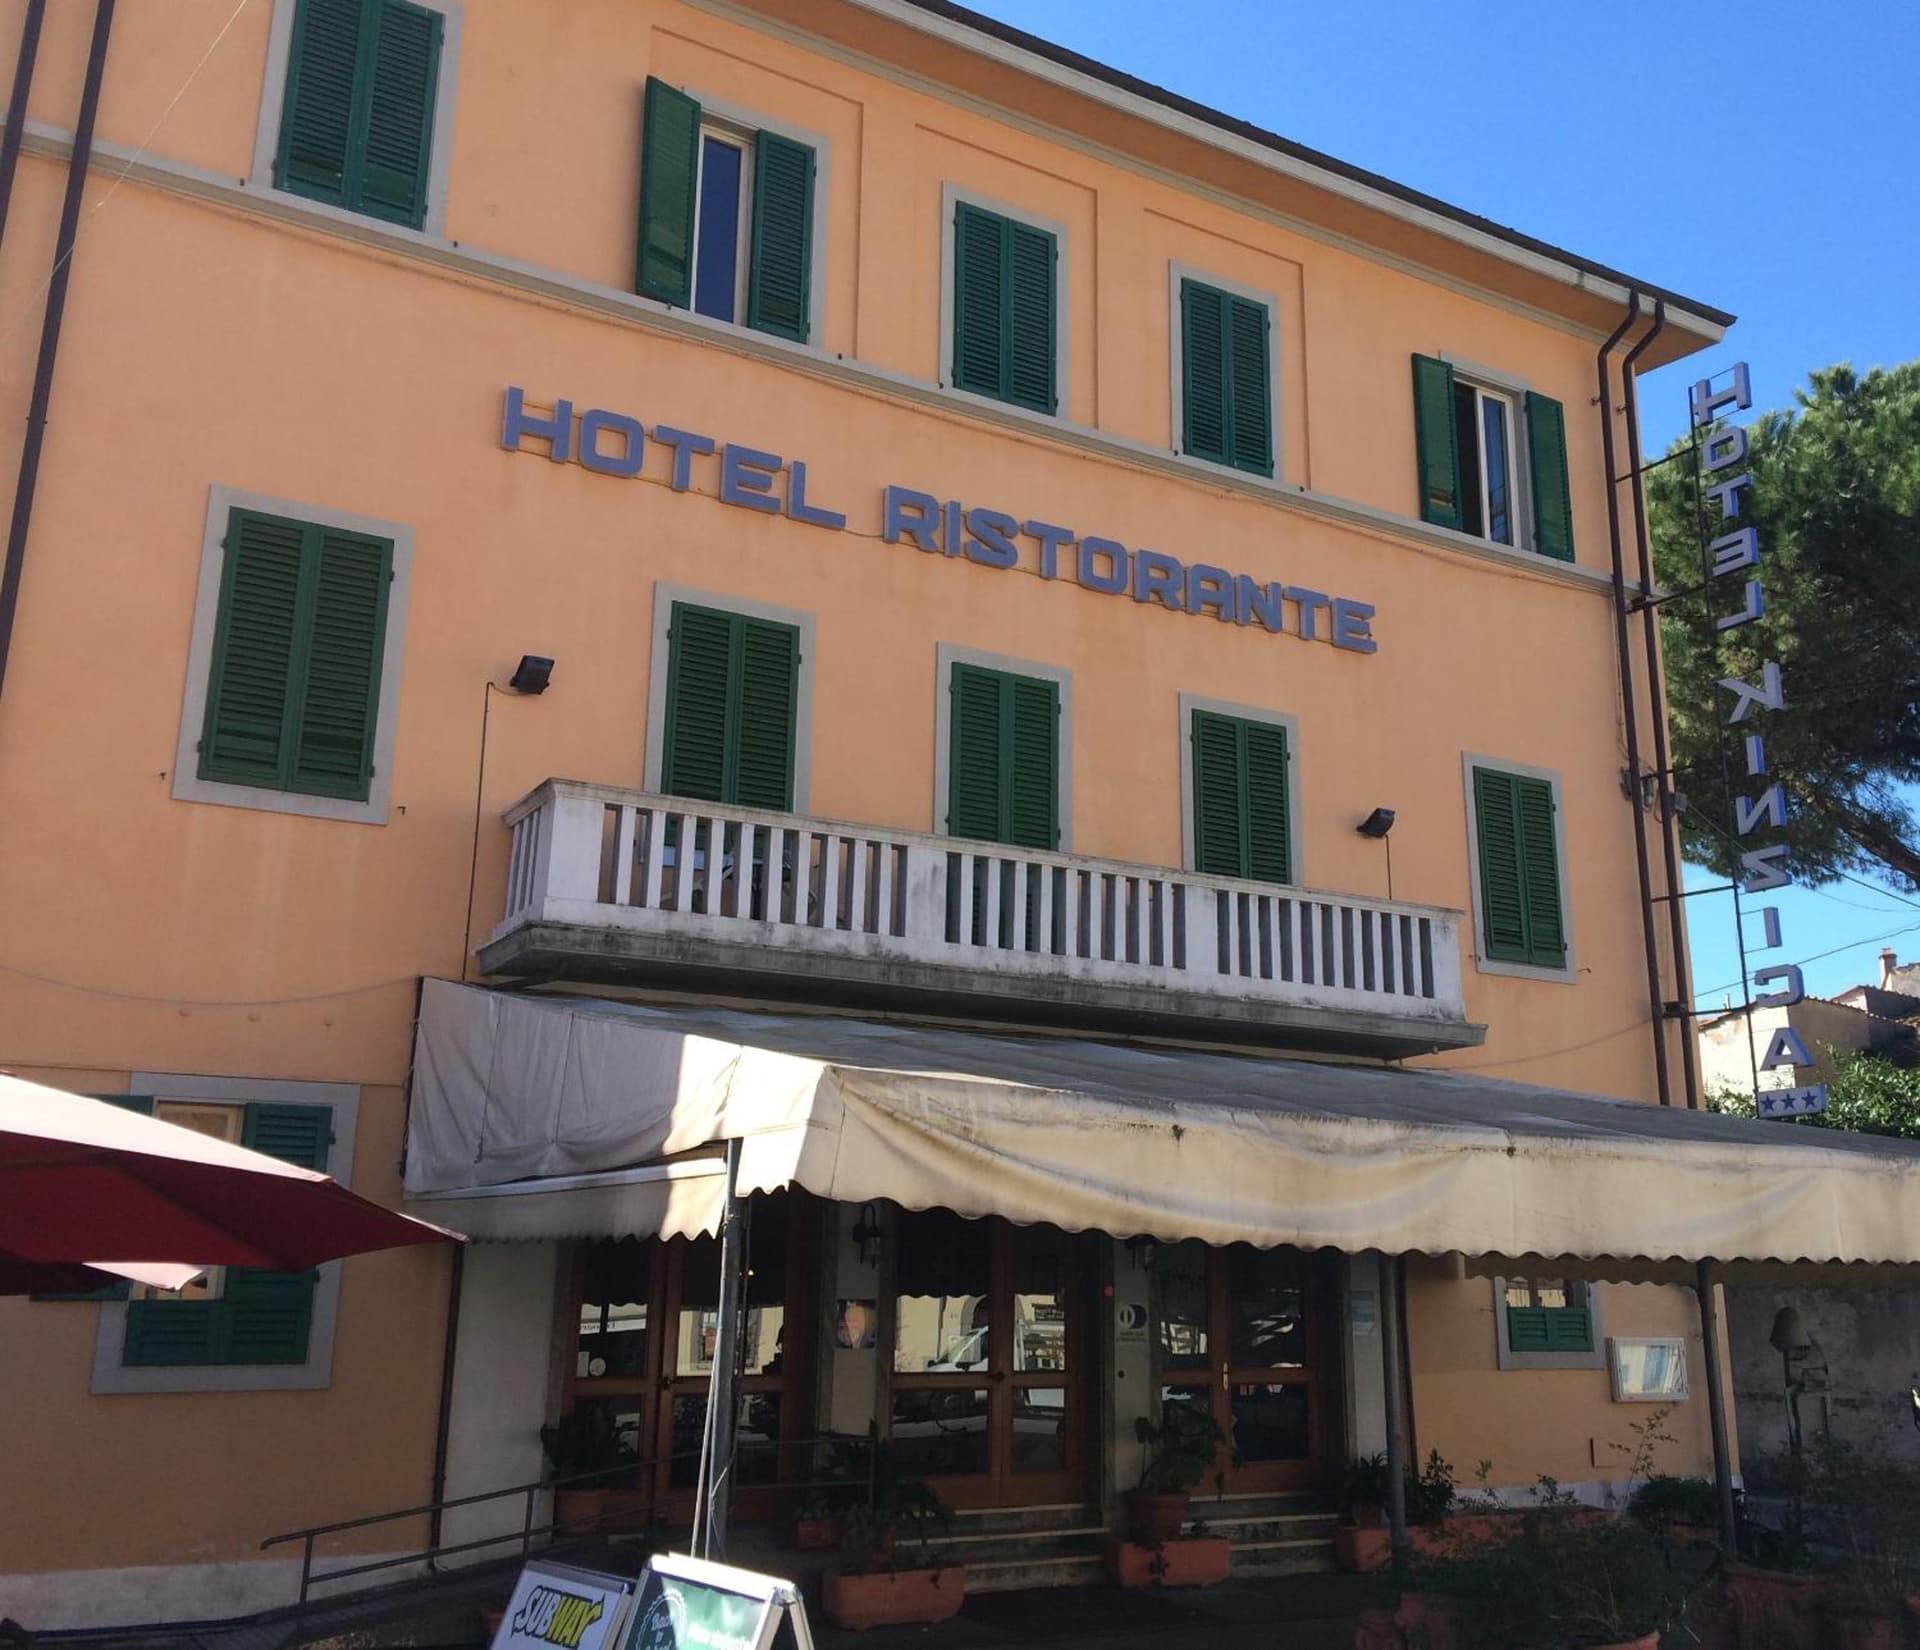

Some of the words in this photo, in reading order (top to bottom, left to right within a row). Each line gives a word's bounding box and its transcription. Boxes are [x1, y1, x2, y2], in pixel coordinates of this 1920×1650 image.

[501, 386, 846, 530] HOTEL
[883, 485, 1378, 653] RISTORANTE
[511, 1585, 605, 1648] SUBWAY
